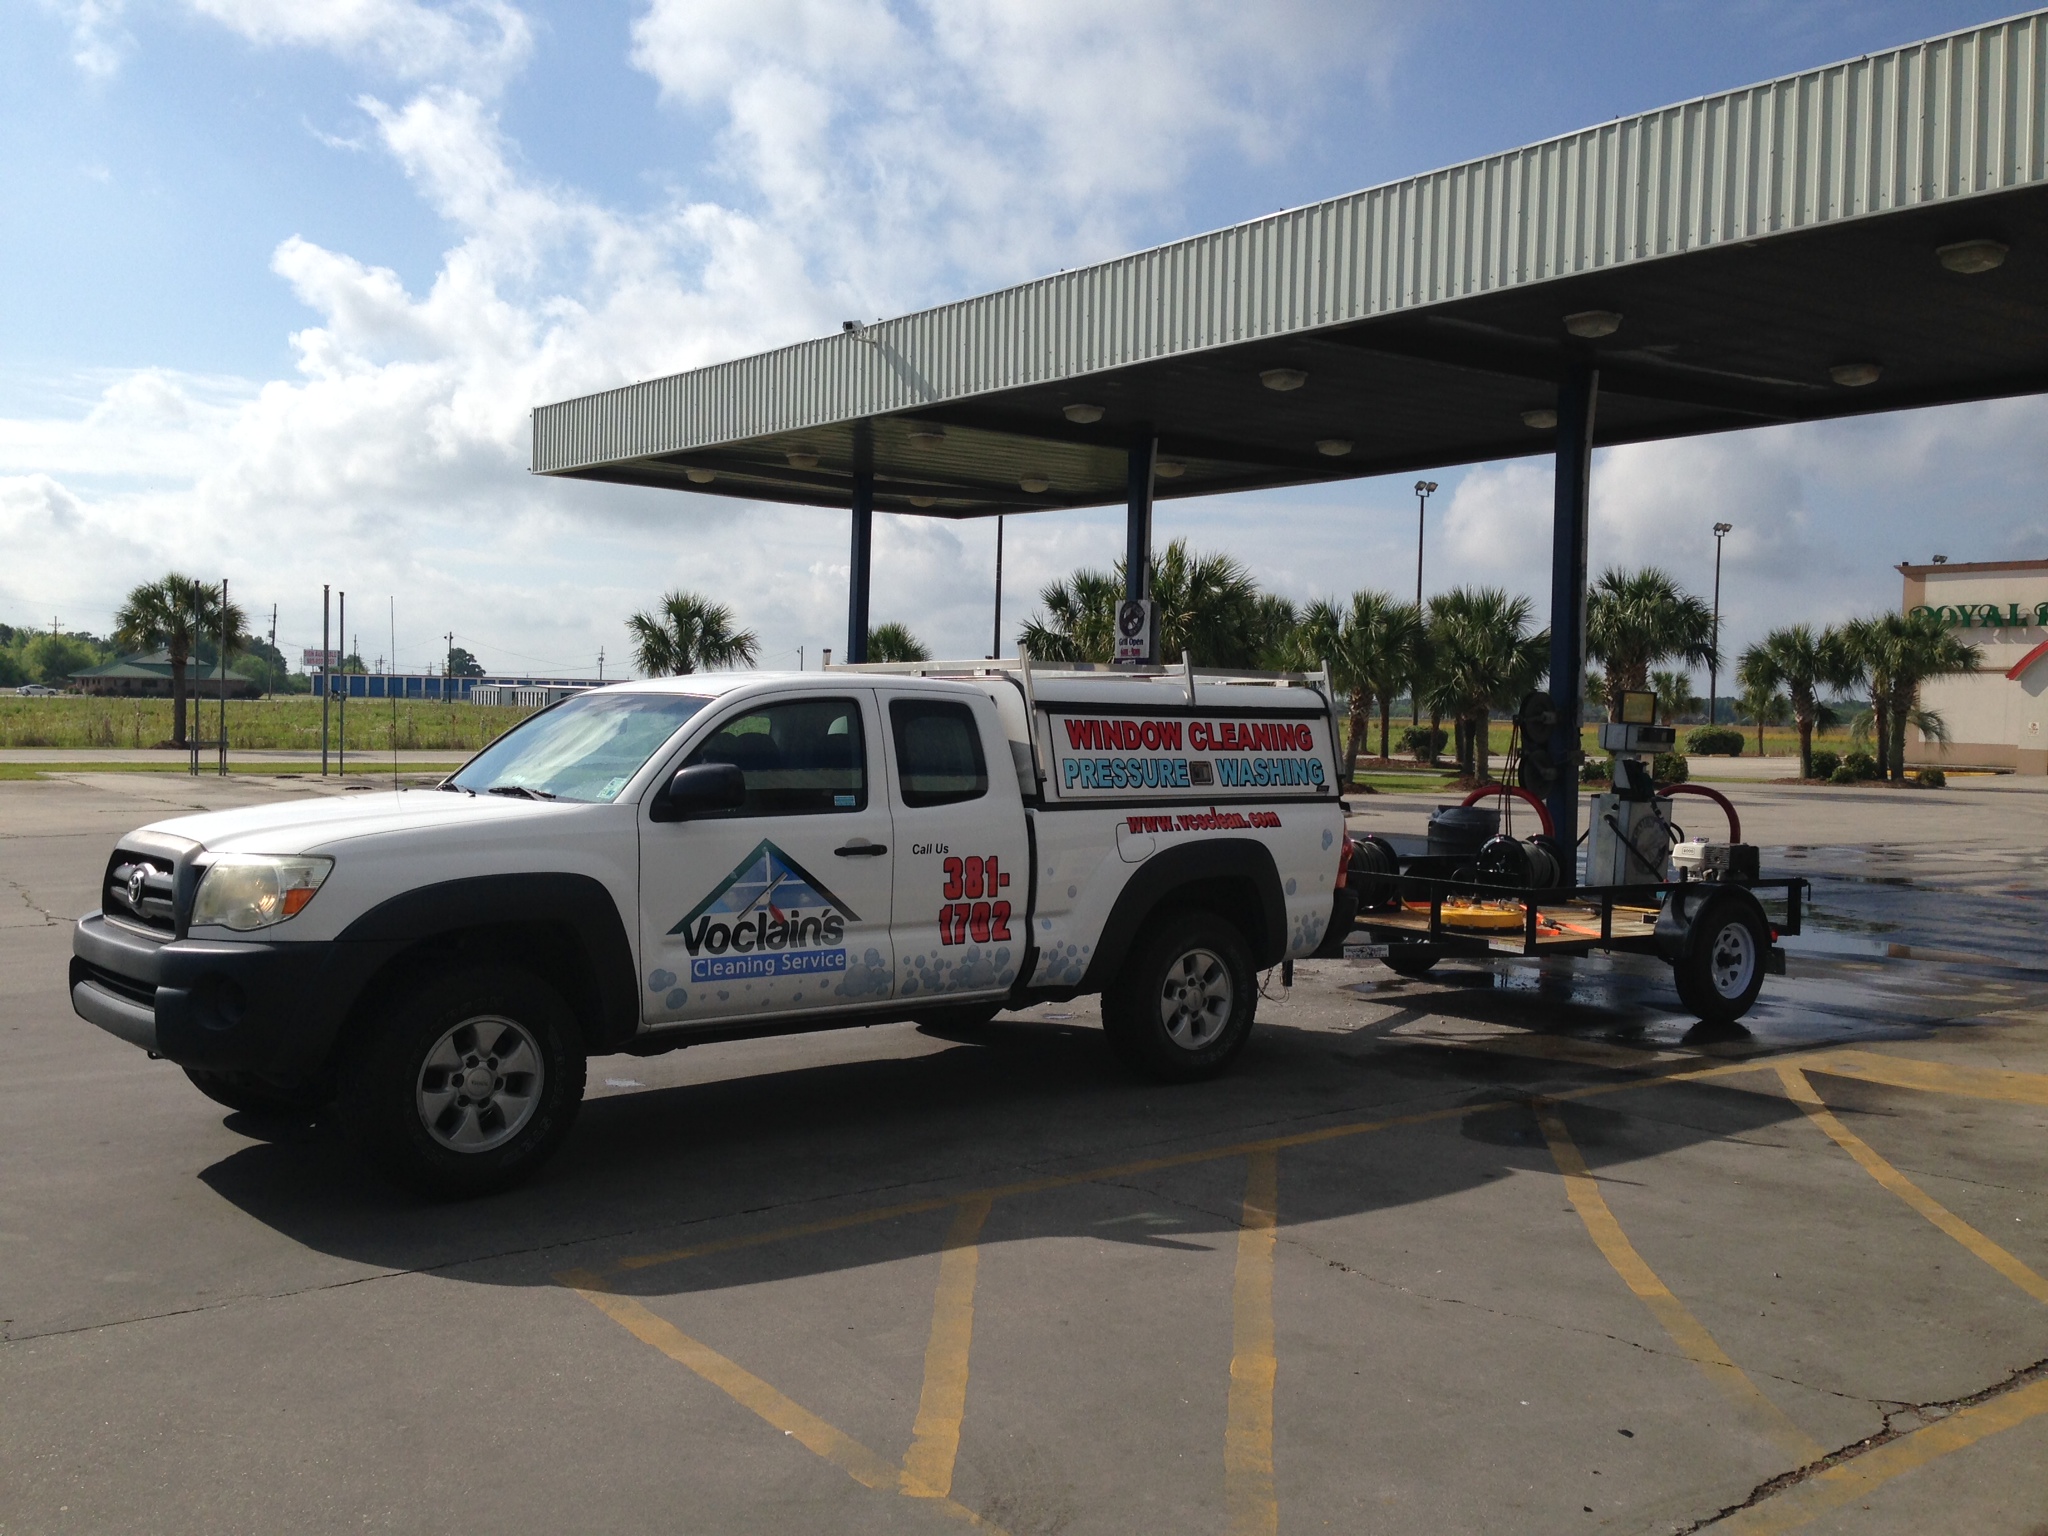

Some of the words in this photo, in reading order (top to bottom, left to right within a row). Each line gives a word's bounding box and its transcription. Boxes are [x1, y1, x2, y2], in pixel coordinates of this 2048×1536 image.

[1064, 719, 1182, 750] WINDOW
[1188, 721, 1313, 751] CLEANING
[1062, 758, 1190, 789] PRESSURE
[1215, 757, 1325, 787] WASHING
[1126, 806, 1282, 834] www.vcsclean.com
[912, 843, 933, 855] Call
[935, 843, 949, 854] Us
[943, 855, 1010, 900] 381-
[683, 908, 845, 957] Voclain's
[939, 900, 1011, 946] 1702
[693, 957, 775, 976] Cleaning
[781, 953, 845, 970] Service
